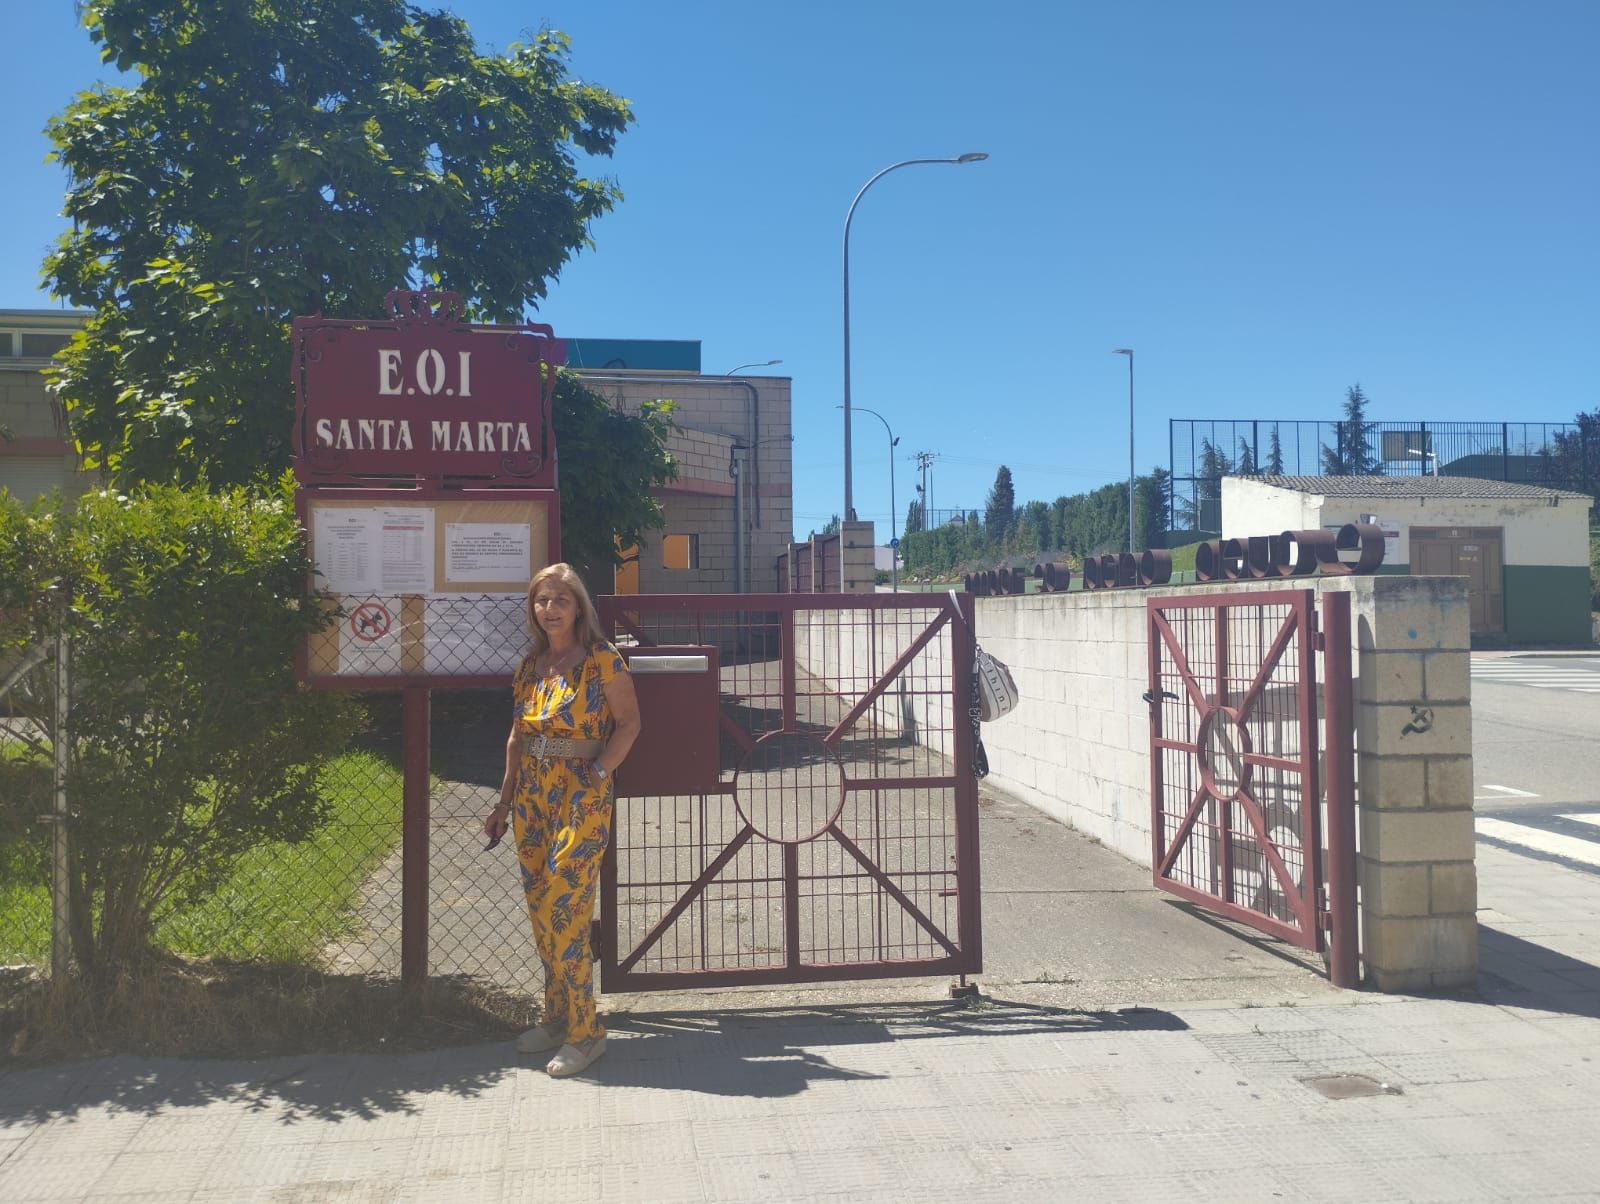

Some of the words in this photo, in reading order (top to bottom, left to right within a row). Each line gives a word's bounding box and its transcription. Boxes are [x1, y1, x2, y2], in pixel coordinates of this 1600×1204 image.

[379, 348, 472, 397] E.O.I
[316, 418, 413, 451] SANTA
[431, 420, 531, 453] MARTA
